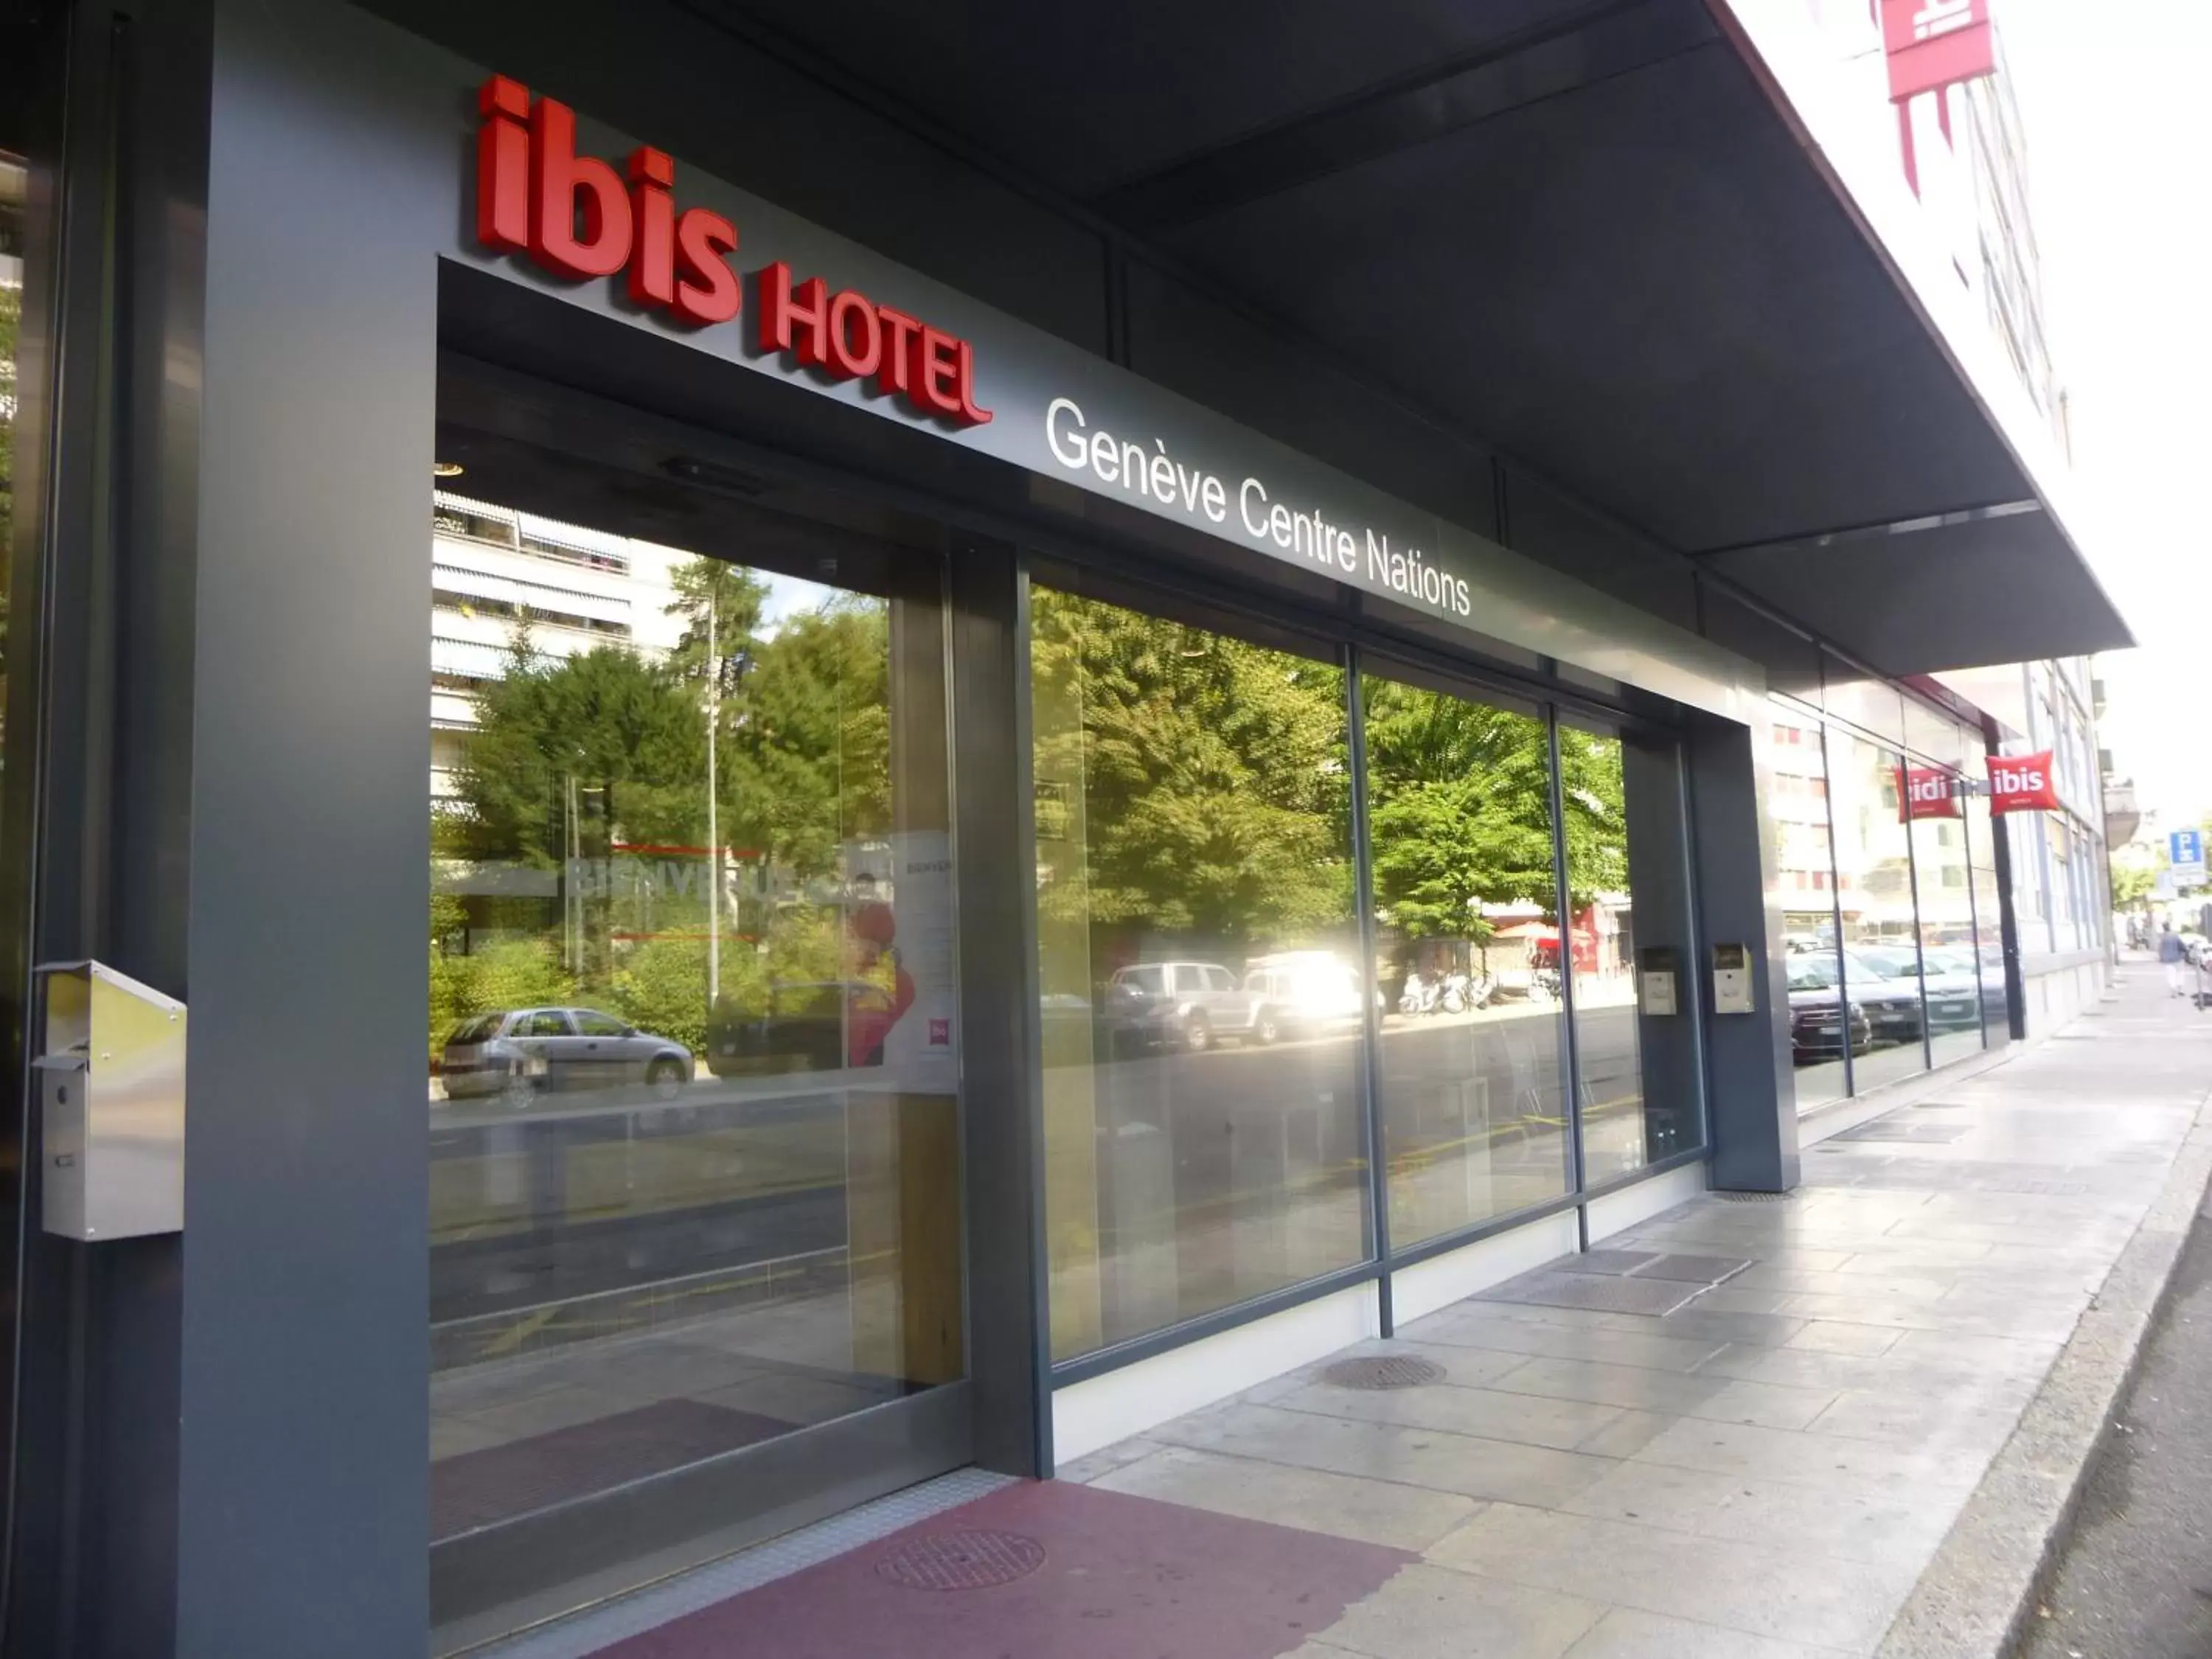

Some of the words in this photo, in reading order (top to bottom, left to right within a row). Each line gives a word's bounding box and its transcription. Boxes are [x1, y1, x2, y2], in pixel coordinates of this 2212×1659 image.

[478, 74, 741, 327] ibis
[758, 261, 993, 426] HOTEL
[1046, 397, 1226, 523] Genève
[1239, 478, 1357, 572] Centre
[1366, 528, 1470, 616] Nations
[1992, 766, 2045, 794] ibis
